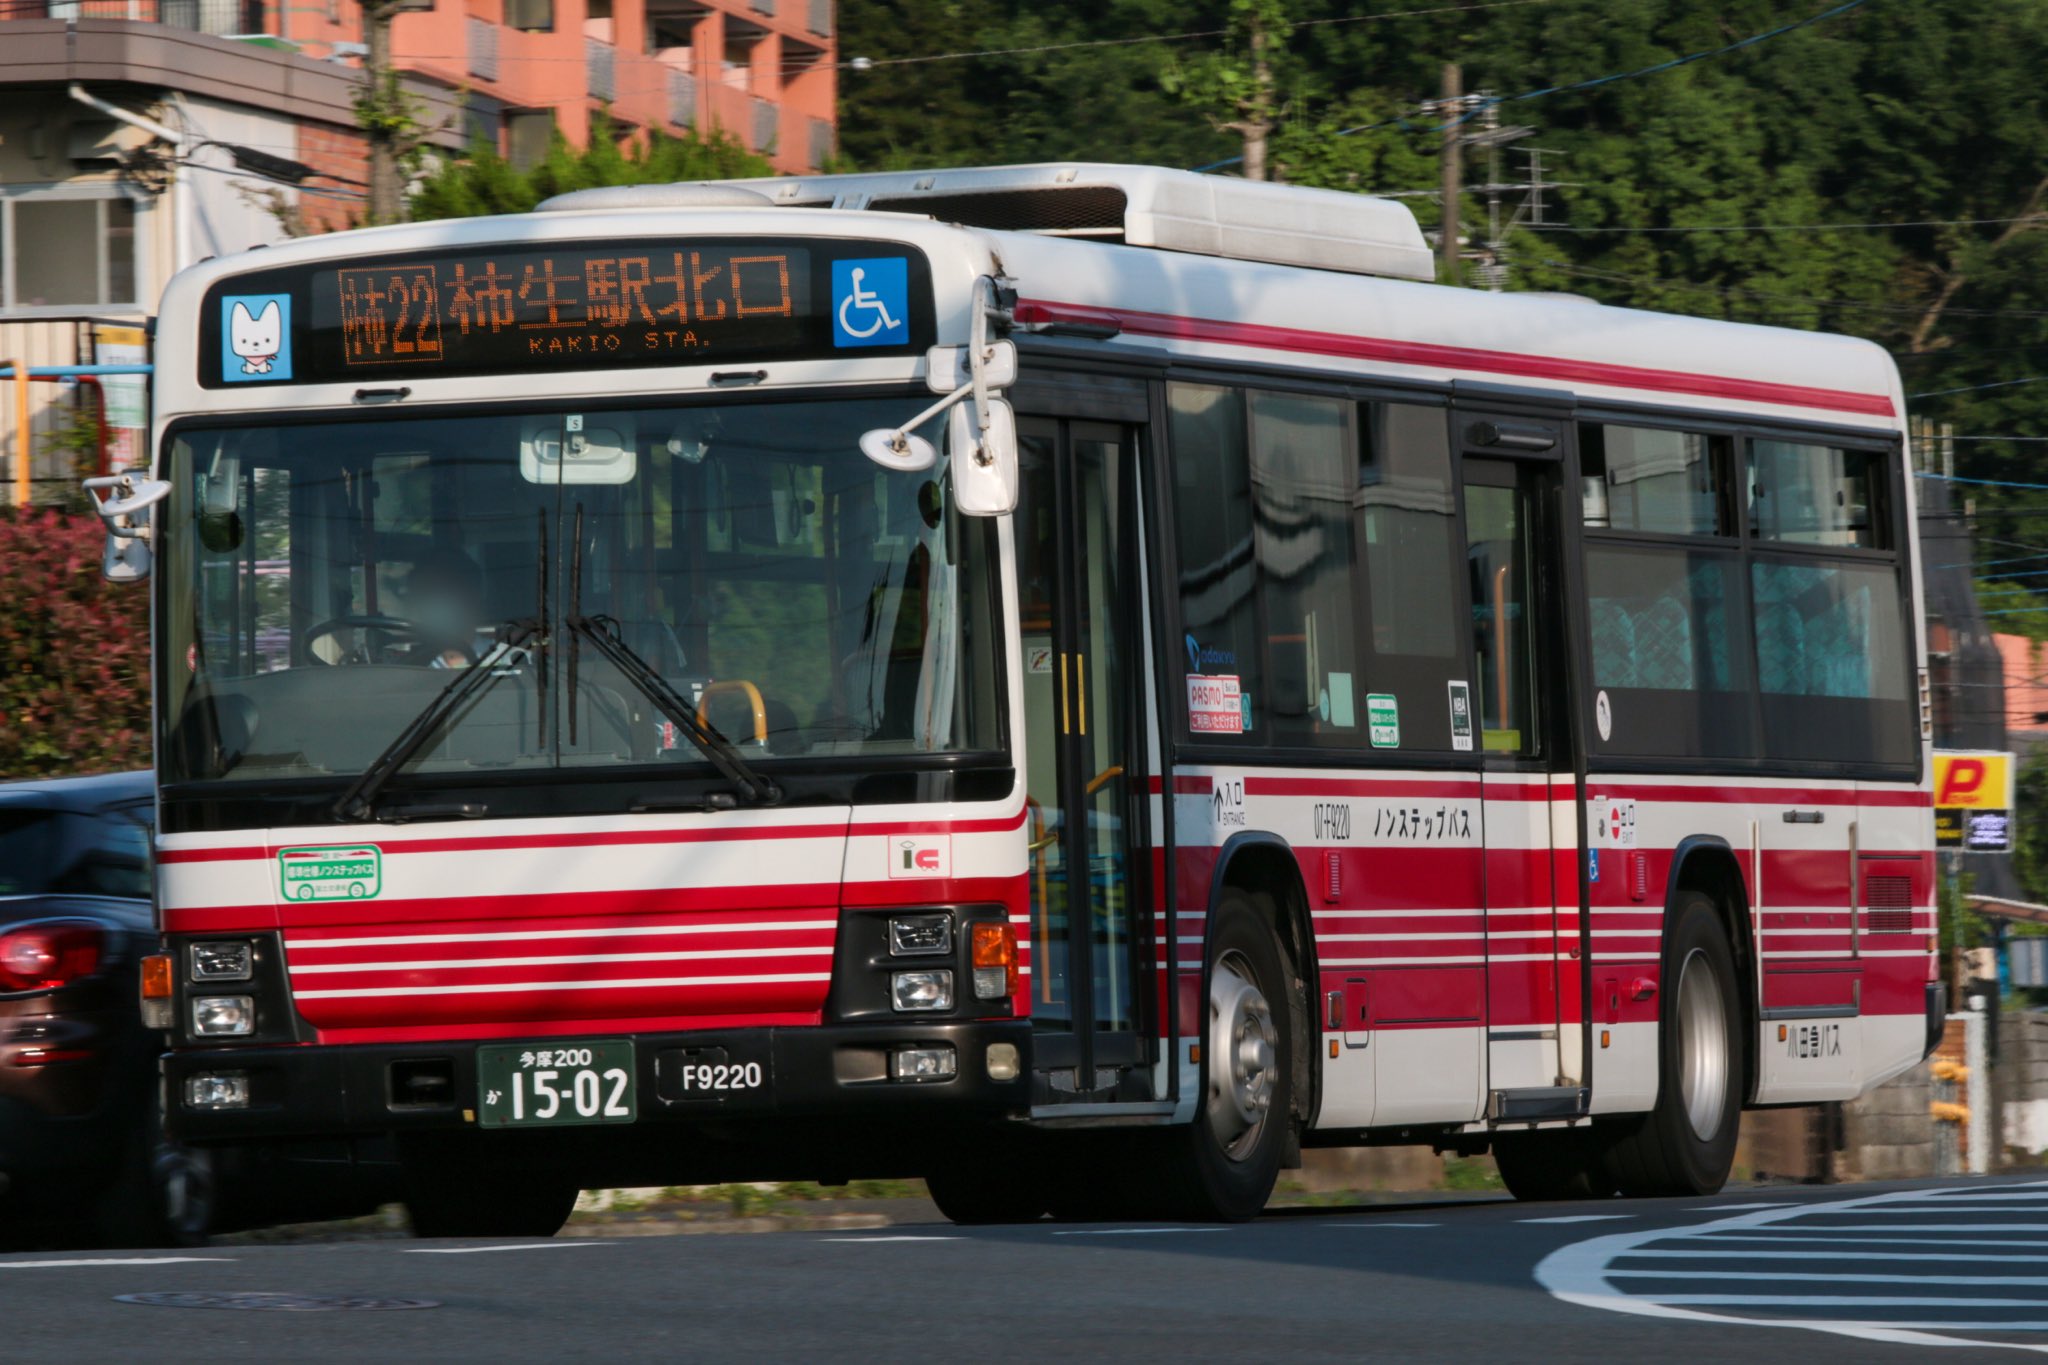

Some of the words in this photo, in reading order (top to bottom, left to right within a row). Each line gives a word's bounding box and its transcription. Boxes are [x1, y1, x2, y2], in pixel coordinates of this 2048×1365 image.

[445, 252, 791, 334] 柿生駅北口
[529, 334, 620, 354] KAKIO
[646, 331, 710, 348] STA.
[1192, 686, 1221, 706] PASMO
[1225, 782, 1242, 806] 入口
[1940, 759, 1986, 804] P
[1314, 804, 1351, 840] 07-F9220
[1374, 806, 1472, 840] ノンステップバス
[519, 1048, 592, 1068] 多摩200
[683, 1062, 761, 1090] F9220
[486, 1090, 502, 1105] か
[512, 1068, 629, 1119] 15-02
